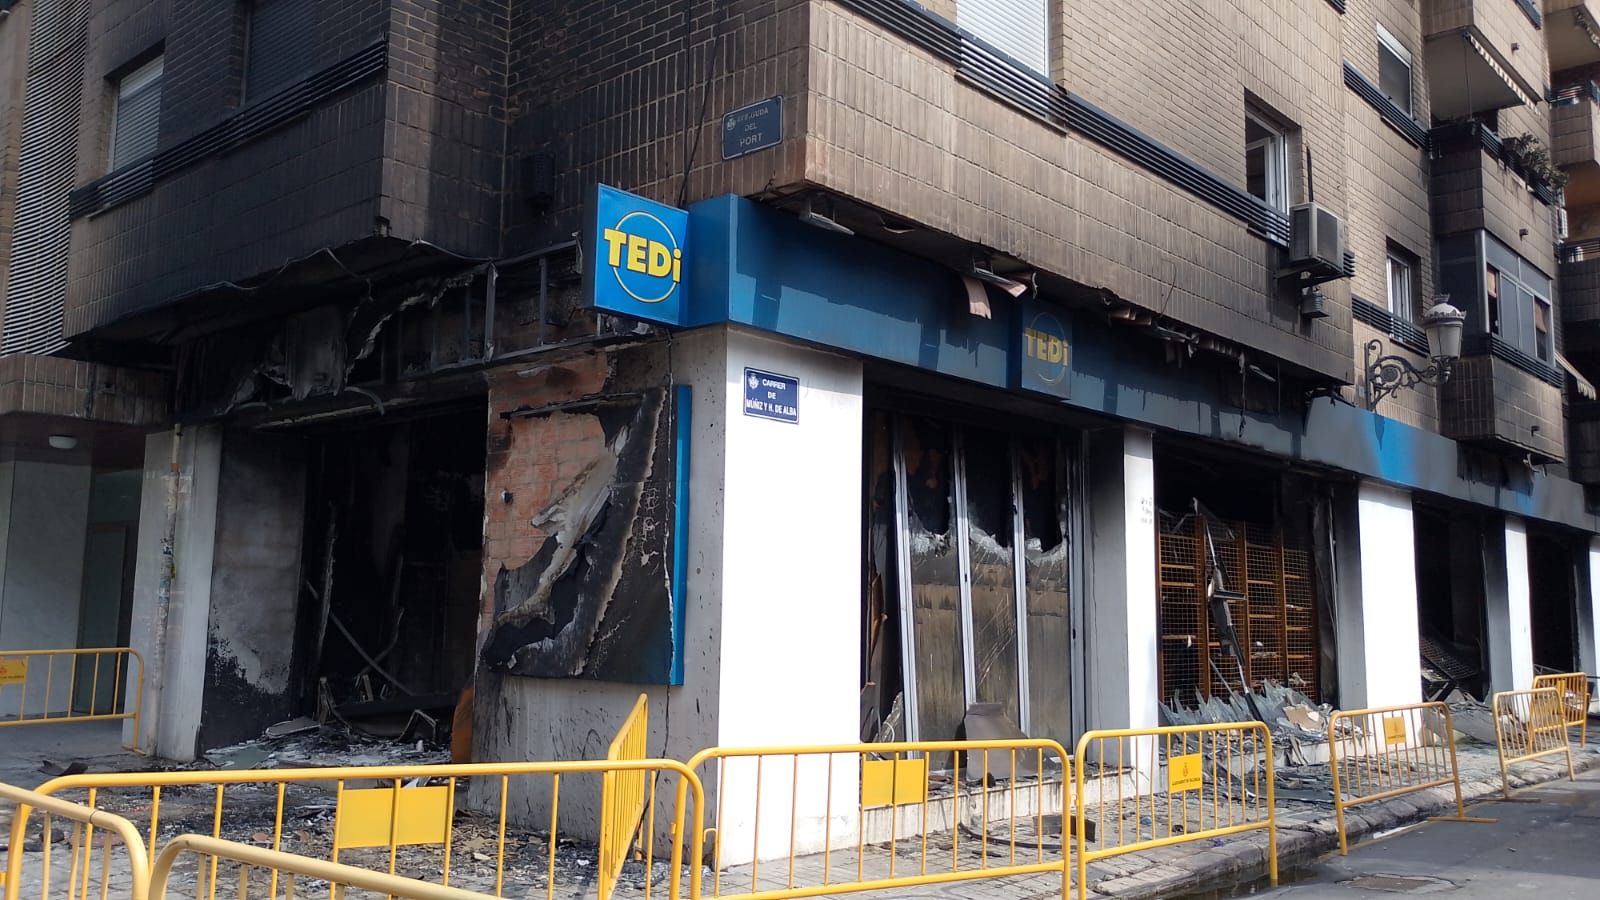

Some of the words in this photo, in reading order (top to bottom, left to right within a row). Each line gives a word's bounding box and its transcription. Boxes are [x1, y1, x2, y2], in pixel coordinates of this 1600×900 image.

[745, 123, 757, 131] DEL
[740, 133, 762, 147] PORT
[604, 228, 681, 282] TEDi
[1024, 327, 1068, 366] TEDi
[762, 378, 786, 390] CARRER
[767, 391, 777, 400] DE
[763, 401, 768, 411] Y
[774, 404, 783, 414] DE
[783, 405, 797, 417] ALBA
